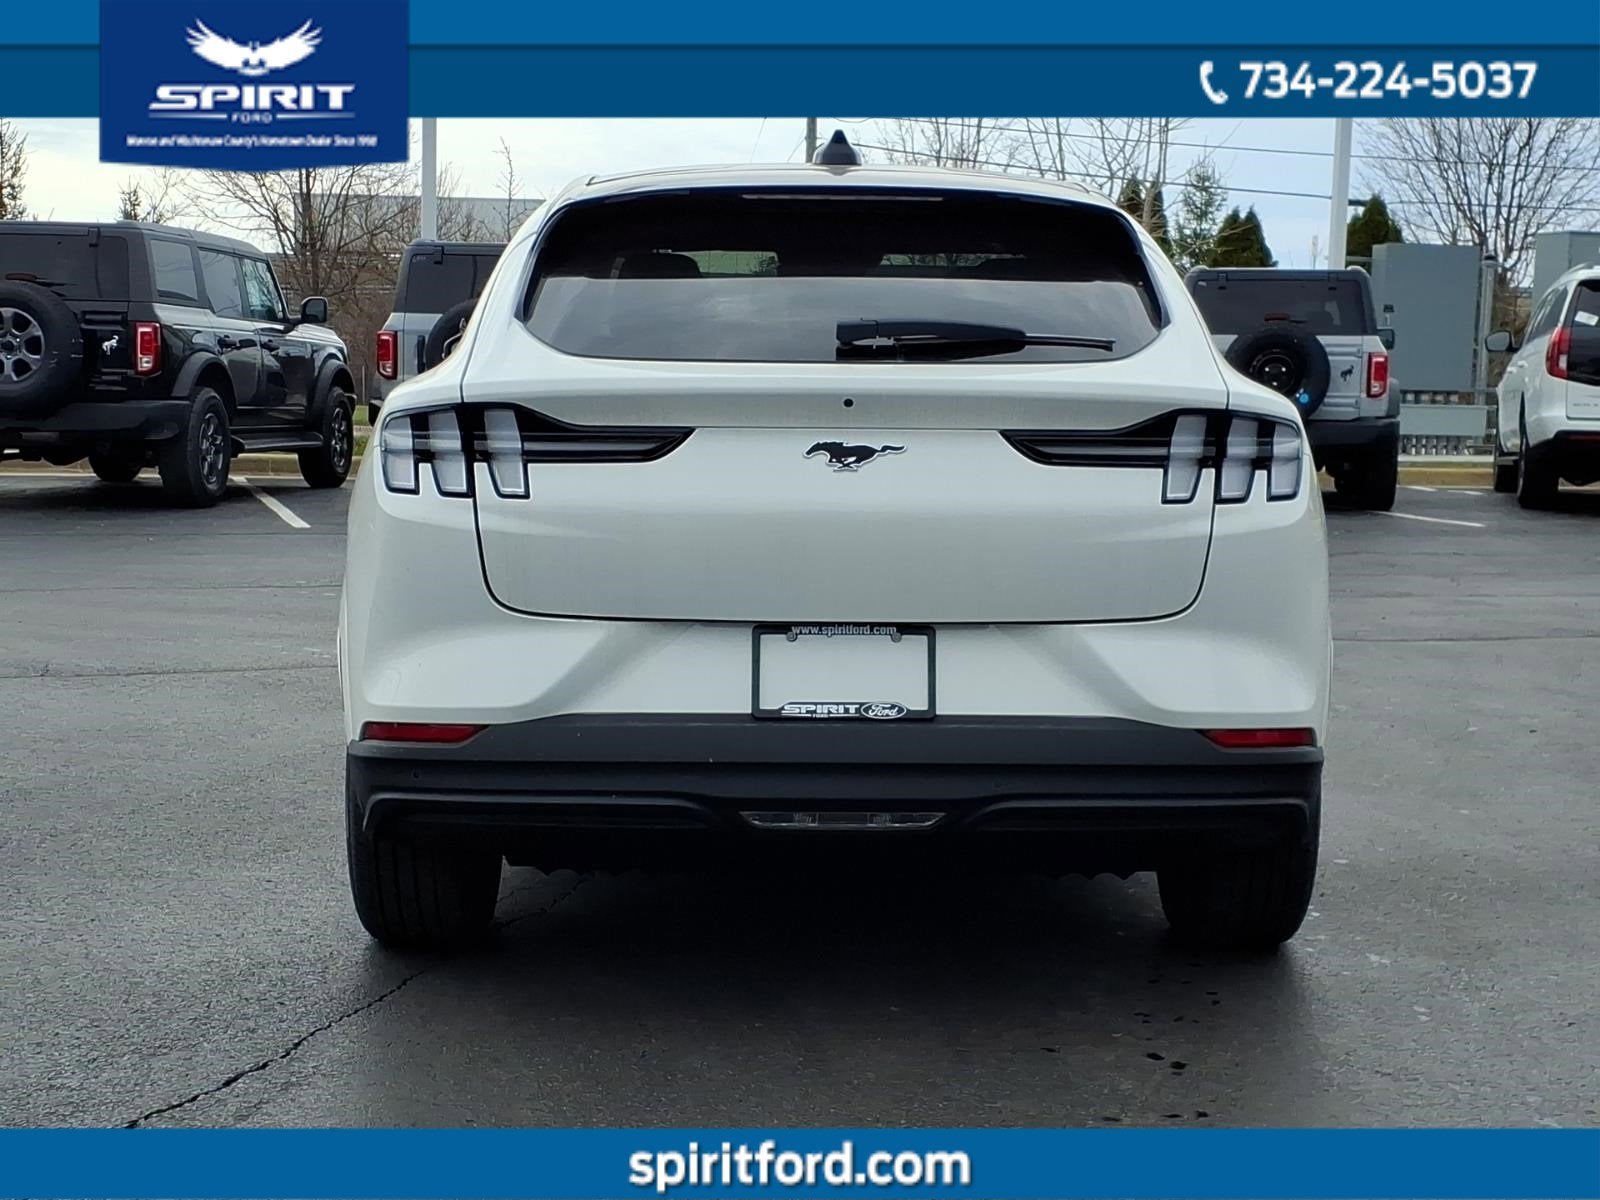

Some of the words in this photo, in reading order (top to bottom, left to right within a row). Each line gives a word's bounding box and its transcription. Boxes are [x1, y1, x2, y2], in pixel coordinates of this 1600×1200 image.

[791, 624, 897, 637] www.spiritford.com
[781, 704, 860, 714] SPIRIT
[868, 702, 899, 716] Ford
